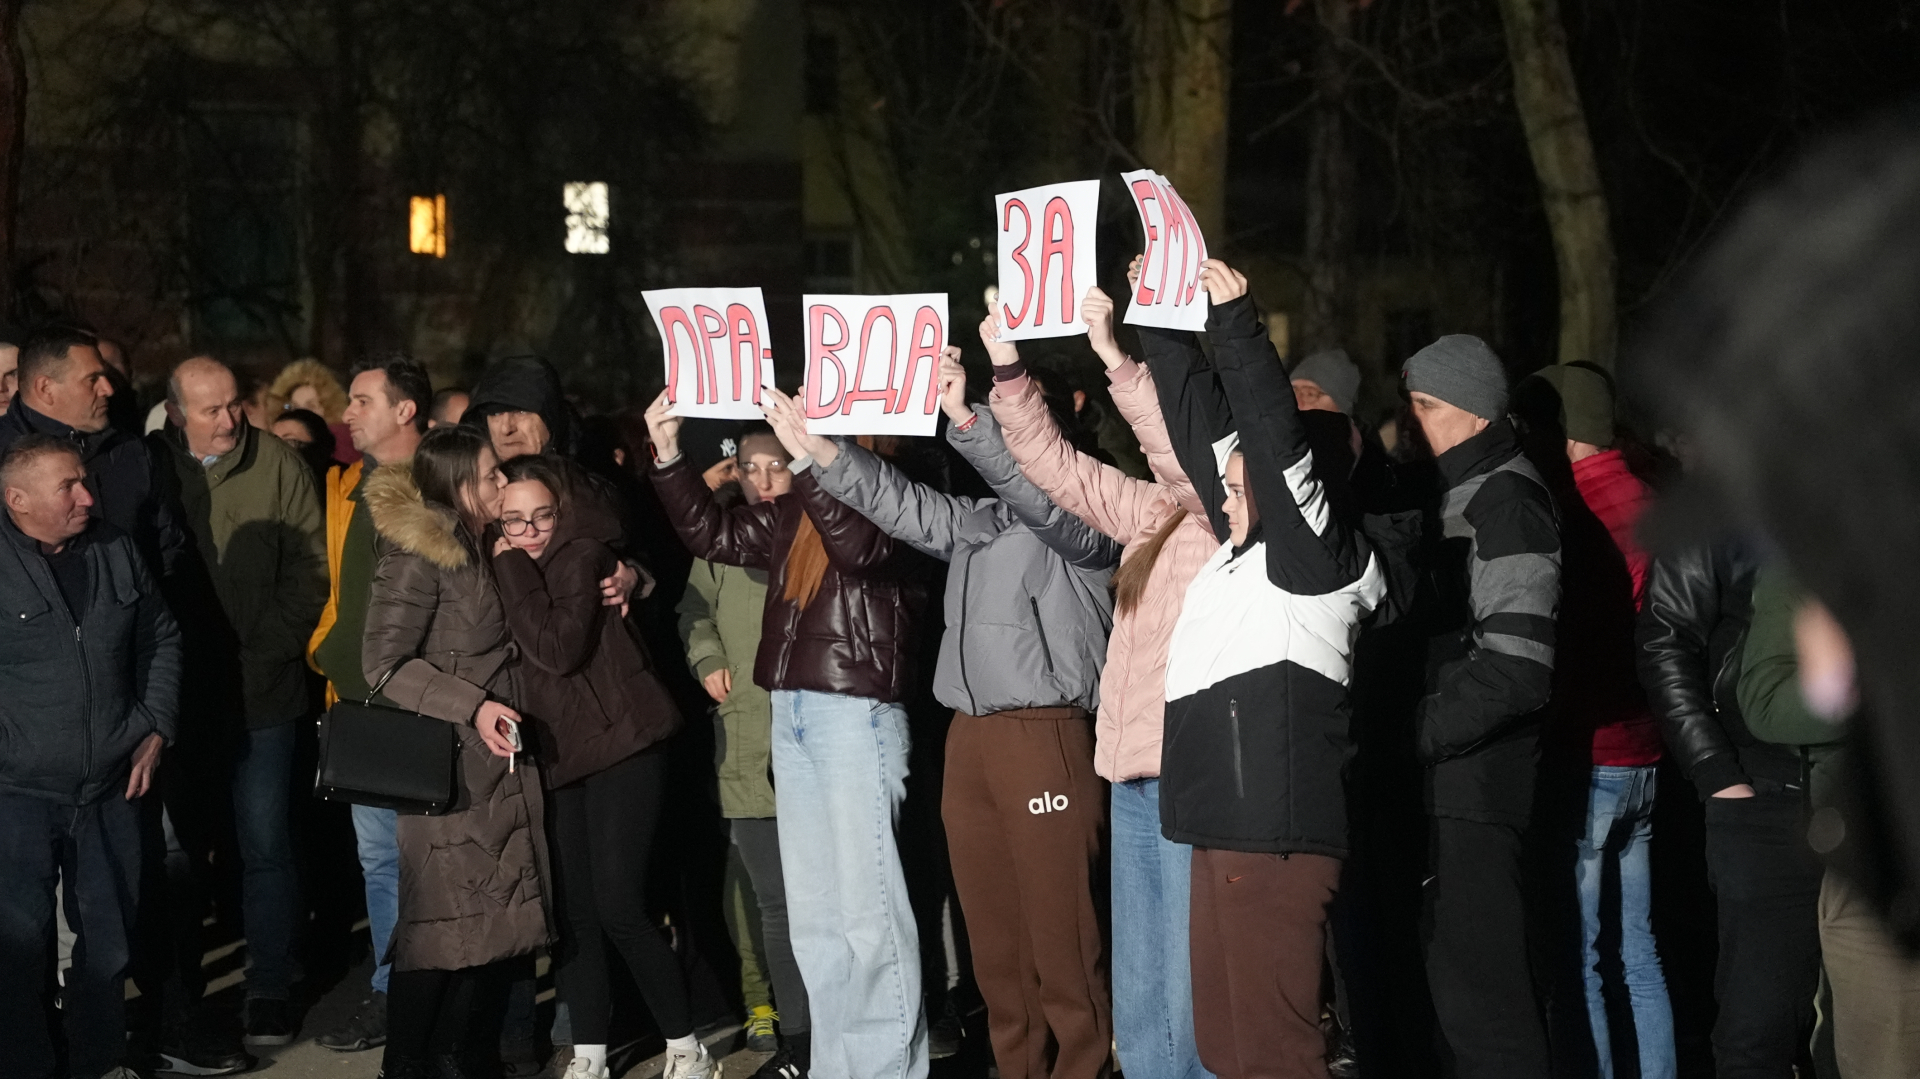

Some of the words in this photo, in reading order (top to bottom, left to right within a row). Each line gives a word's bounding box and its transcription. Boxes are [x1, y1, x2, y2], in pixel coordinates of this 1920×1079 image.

[1003, 196, 1074, 329] ЗА
[806, 304, 942, 419] ВДА
[1028, 790, 1069, 815] alo
